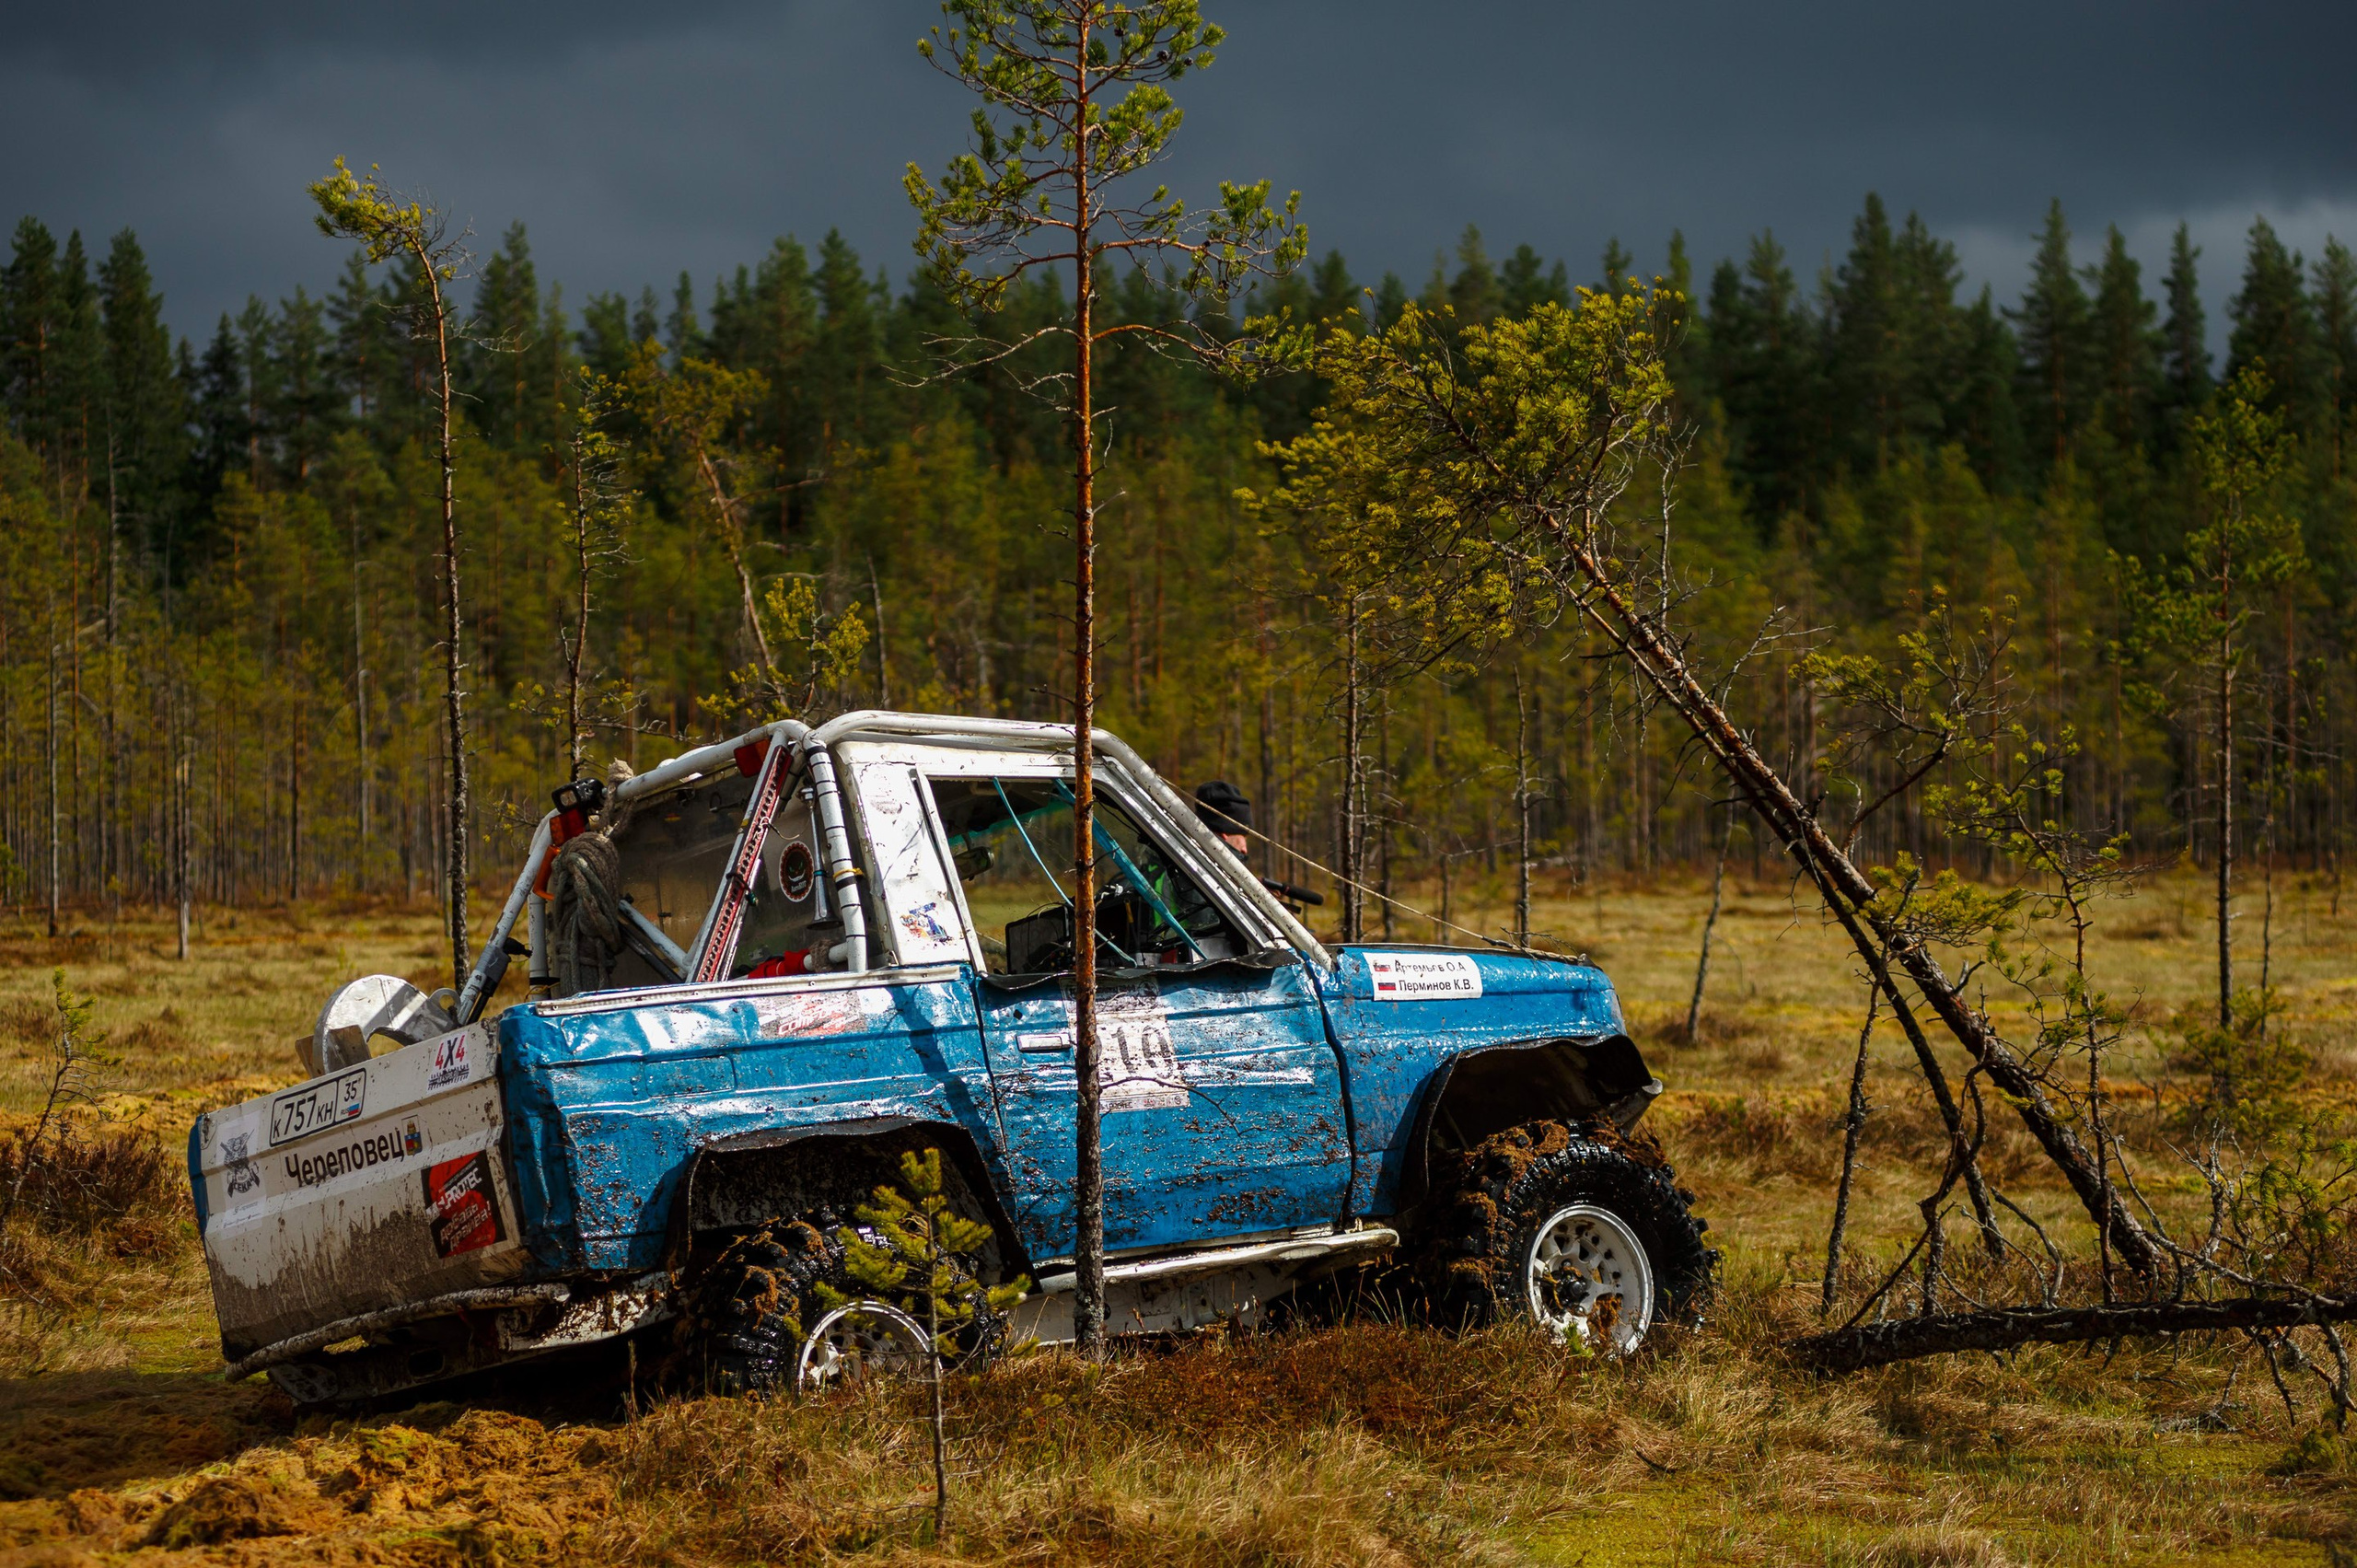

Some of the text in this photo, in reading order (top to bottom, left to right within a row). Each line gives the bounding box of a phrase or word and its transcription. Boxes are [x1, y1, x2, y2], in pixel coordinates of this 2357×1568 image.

[1399, 979, 1474, 993] Перминов К.В.
[344, 1079, 358, 1102] 35
[284, 1130, 405, 1188] Череповец
